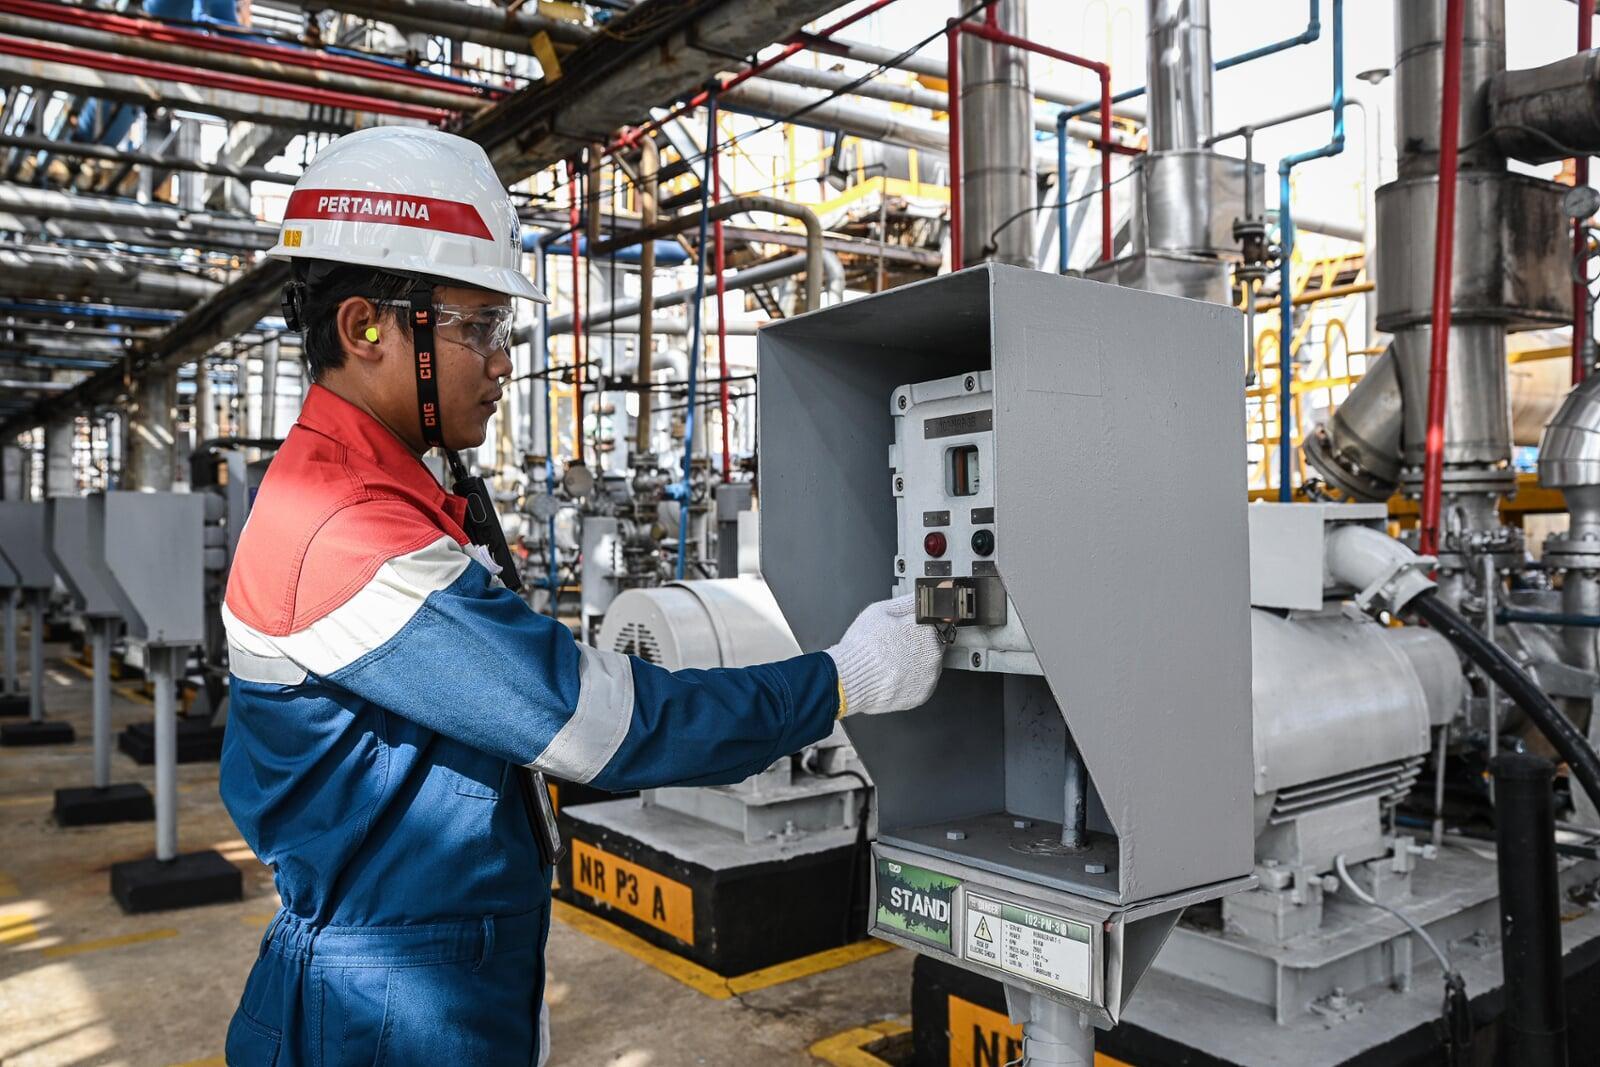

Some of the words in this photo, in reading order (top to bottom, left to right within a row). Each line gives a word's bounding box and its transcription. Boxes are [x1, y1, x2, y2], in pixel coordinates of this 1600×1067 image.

[318, 196, 430, 221] PERTAMINA
[419, 351, 432, 379] CIG
[423, 402, 436, 427] CIG
[580, 853, 606, 893] NR
[616, 868, 639, 907] P3
[653, 885, 666, 922] A
[890, 886, 951, 924] STAND
